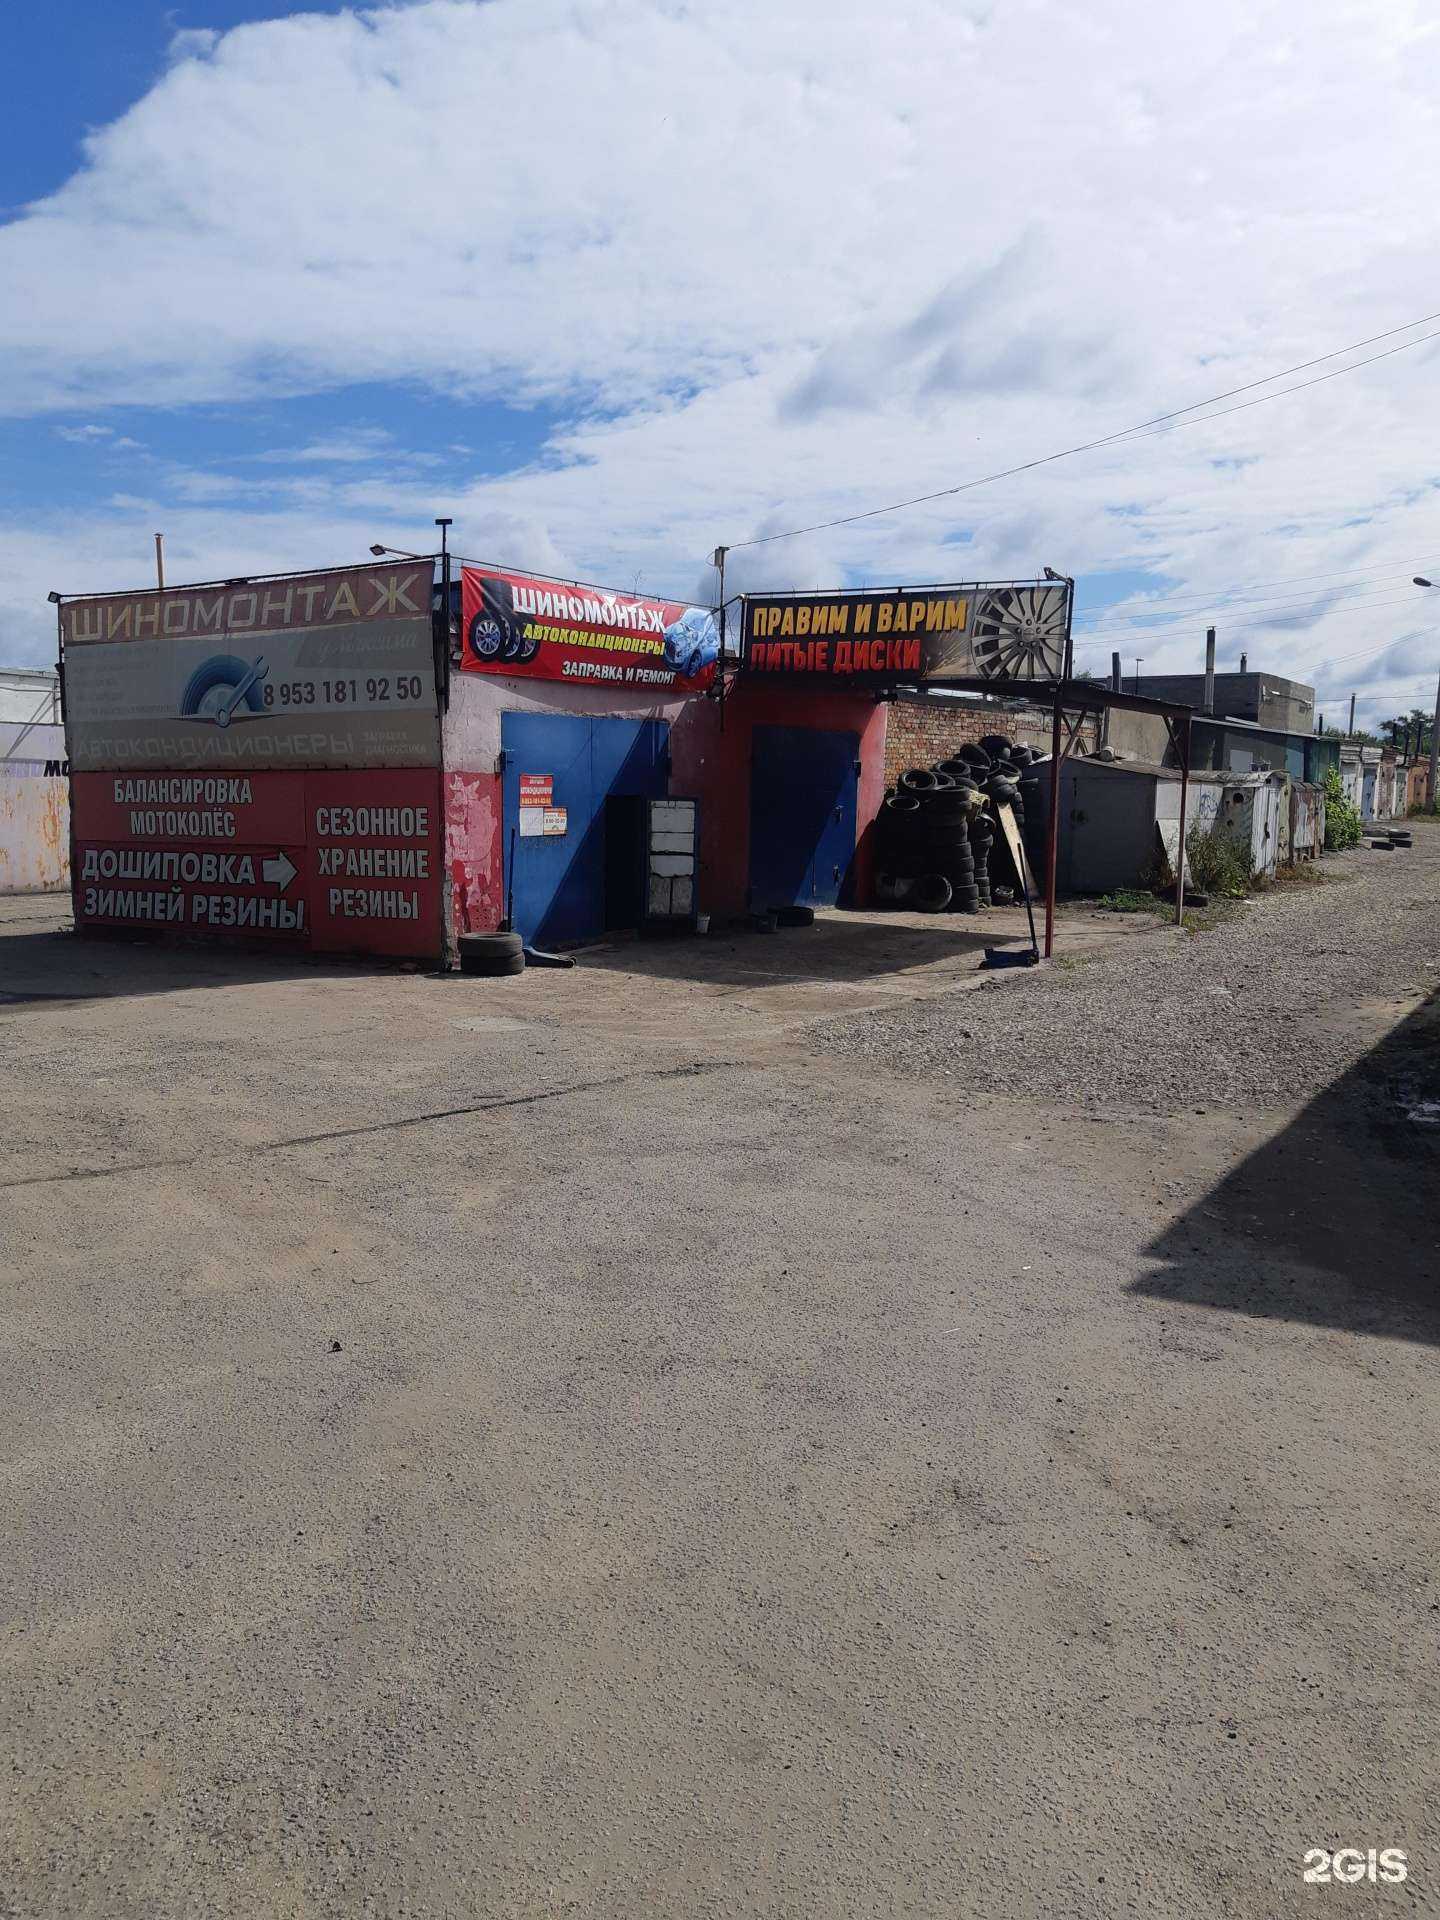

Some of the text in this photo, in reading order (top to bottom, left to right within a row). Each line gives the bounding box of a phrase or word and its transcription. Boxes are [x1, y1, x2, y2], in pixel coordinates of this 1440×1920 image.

[70, 573, 422, 642] ШИНОМОНТАЖ
[512, 586, 666, 634] ШИНОМОНТАЖ
[753, 599, 969, 637] ПРАВИМ И ВАРИМ
[523, 623, 665, 656] АВТОКОНДИЦИОНЕРЫ
[562, 660, 677, 685] ЗАПРАВКА И РЕМОНТ
[833, 639, 922, 674] ДИСКИ
[263, 675, 423, 707] 8 953 181 92 50
[113, 778, 253, 804] БАЛАНСИРОВКА
[131, 808, 236, 838] МОТОКОЛЁС
[316, 807, 430, 837] СЕЗОННОЕ
[81, 849, 256, 885] ДОШИПОВКА
[317, 847, 430, 879] ХРАНЕНИЕ
[84, 887, 304, 930] ЗИМНЕЙ РЕЗИНЫ
[329, 888, 419, 920] РЕЗИНЫ
